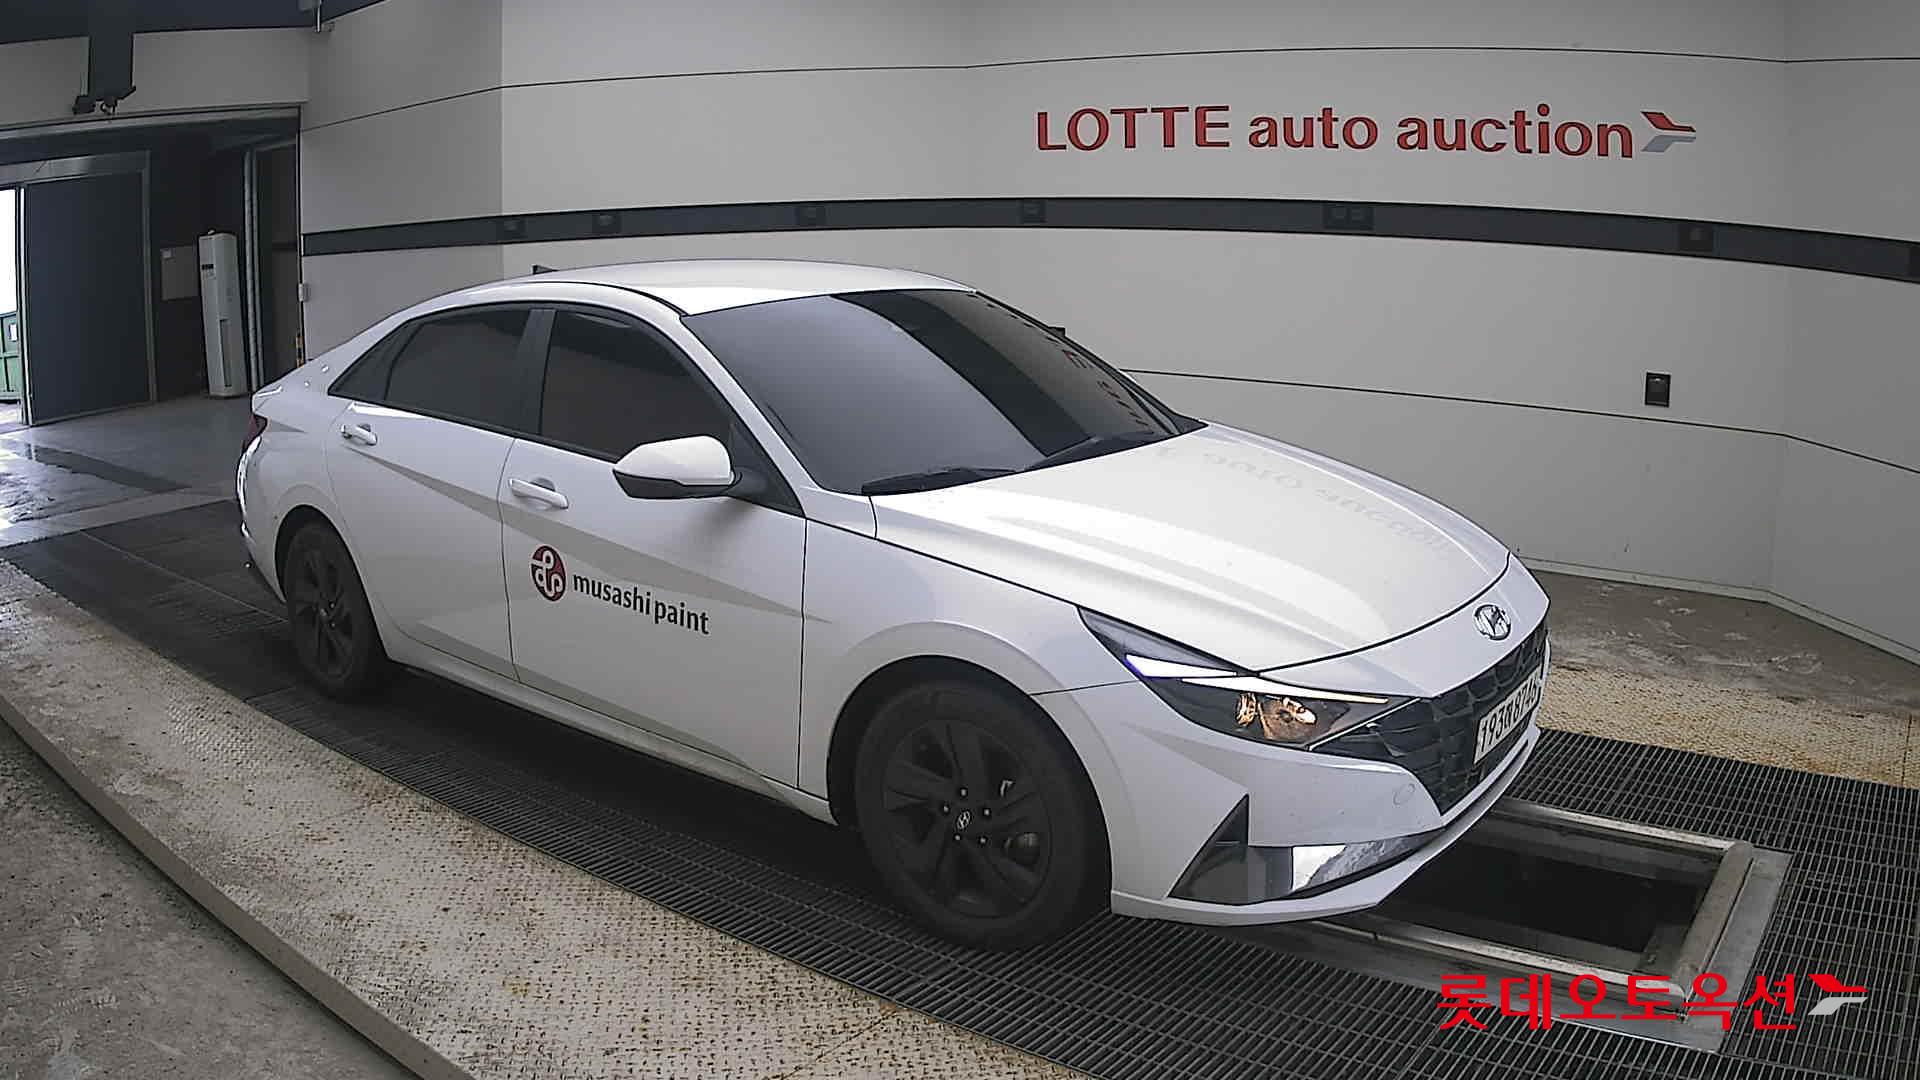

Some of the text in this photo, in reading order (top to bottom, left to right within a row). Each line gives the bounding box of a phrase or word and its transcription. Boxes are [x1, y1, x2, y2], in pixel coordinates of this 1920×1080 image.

[1036, 103, 1634, 159] LOTTE auto auction
[572, 573, 710, 635] musashi paint
